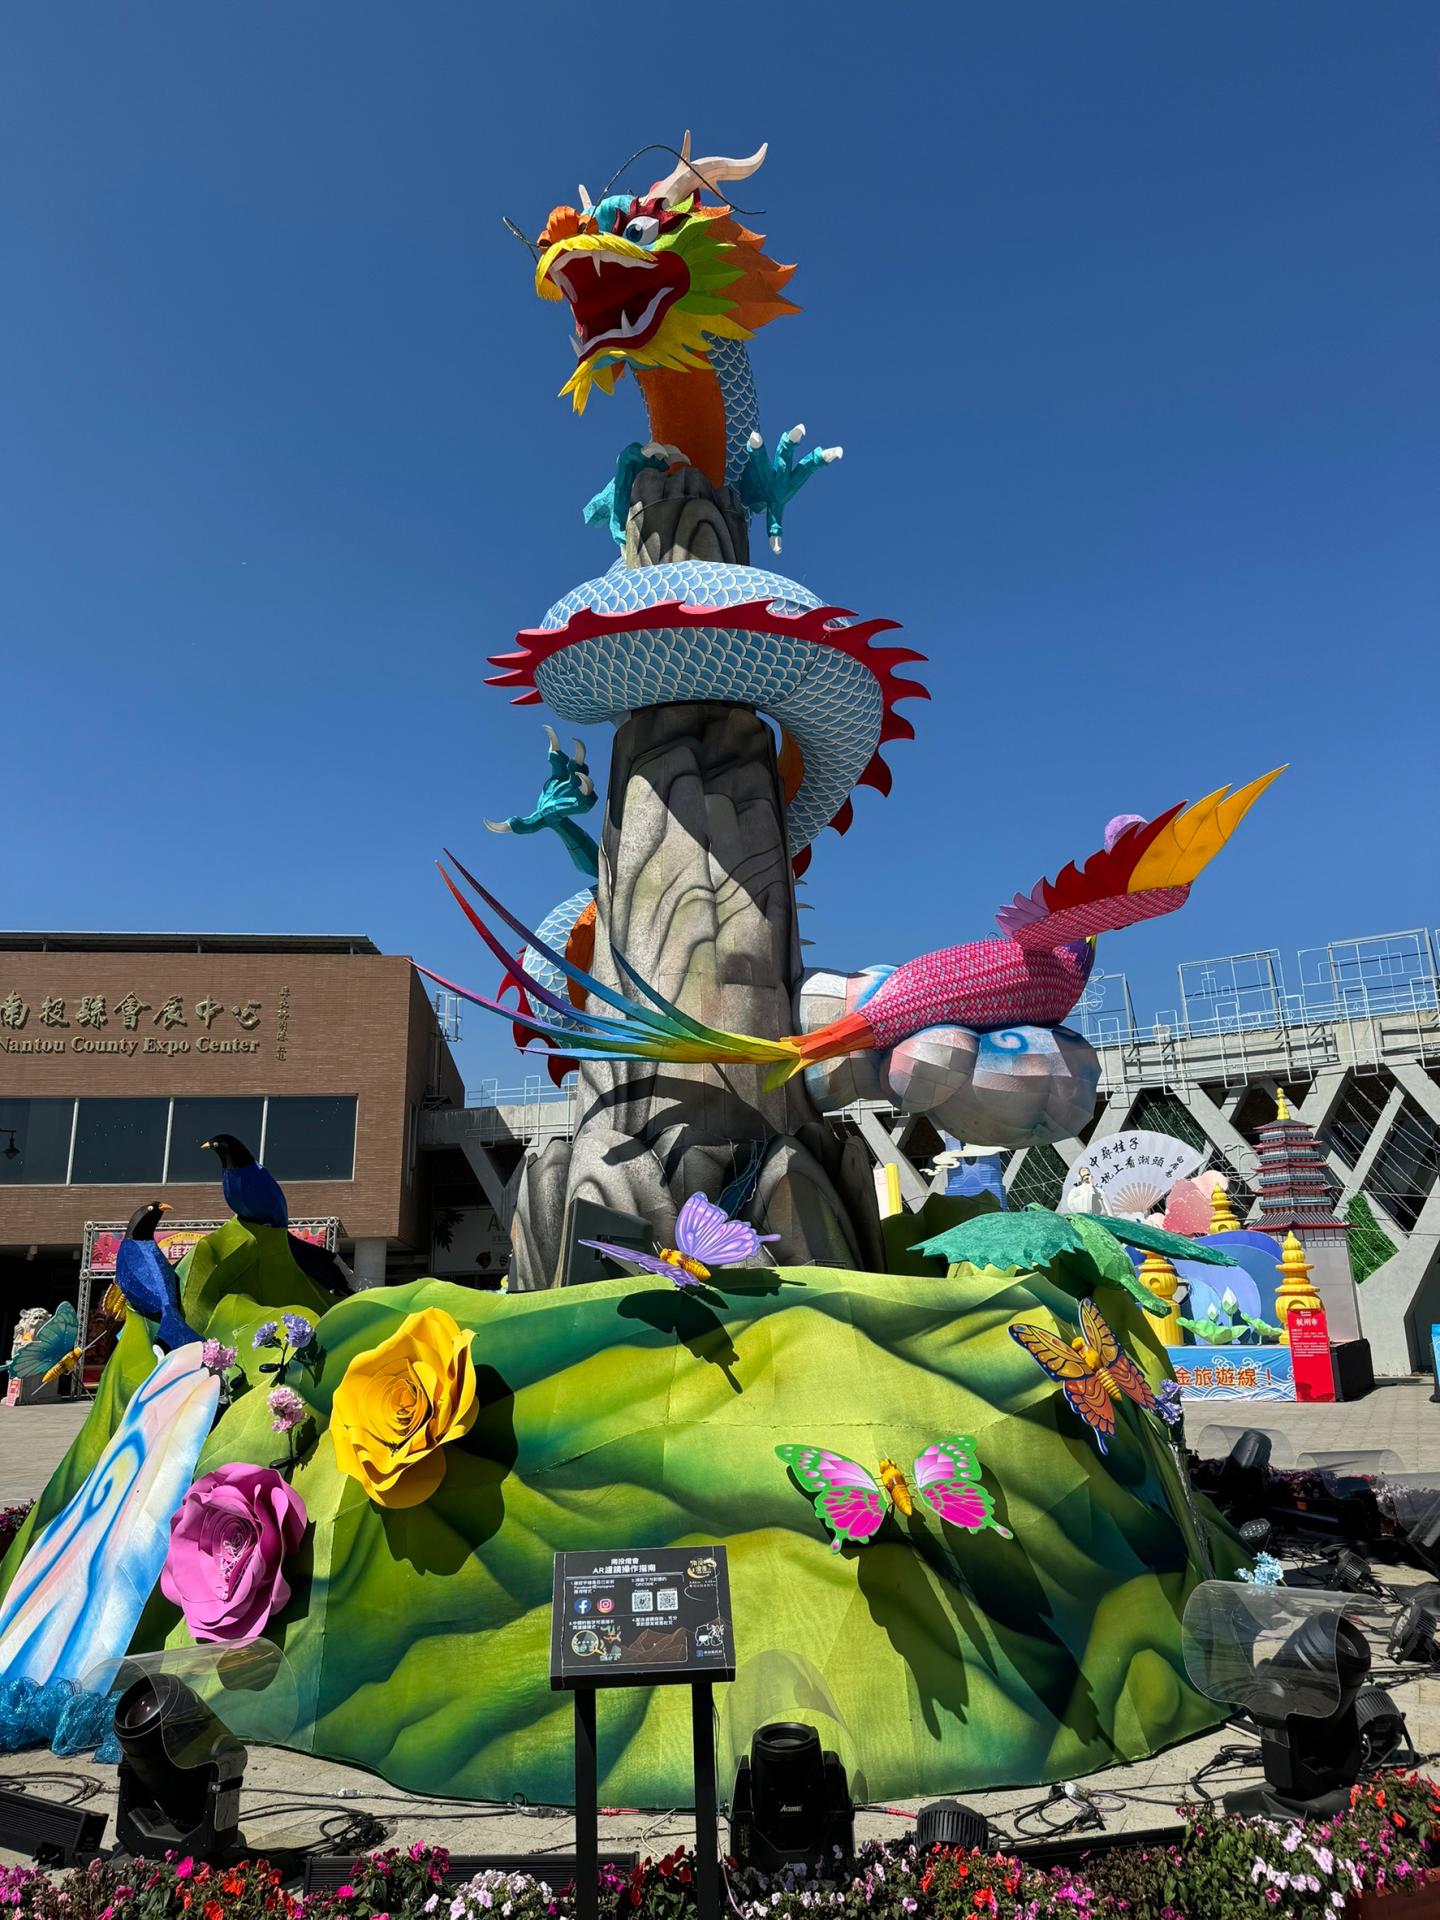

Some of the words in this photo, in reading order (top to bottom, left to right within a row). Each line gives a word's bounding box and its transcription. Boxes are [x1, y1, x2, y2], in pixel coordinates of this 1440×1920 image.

[0, 990, 261, 1030] 南投縣會展中心
[0, 1036, 65, 1053] Nantou
[71, 1036, 138, 1057] County
[143, 1037, 190, 1057] Expo
[195, 1036, 260, 1053] Center
